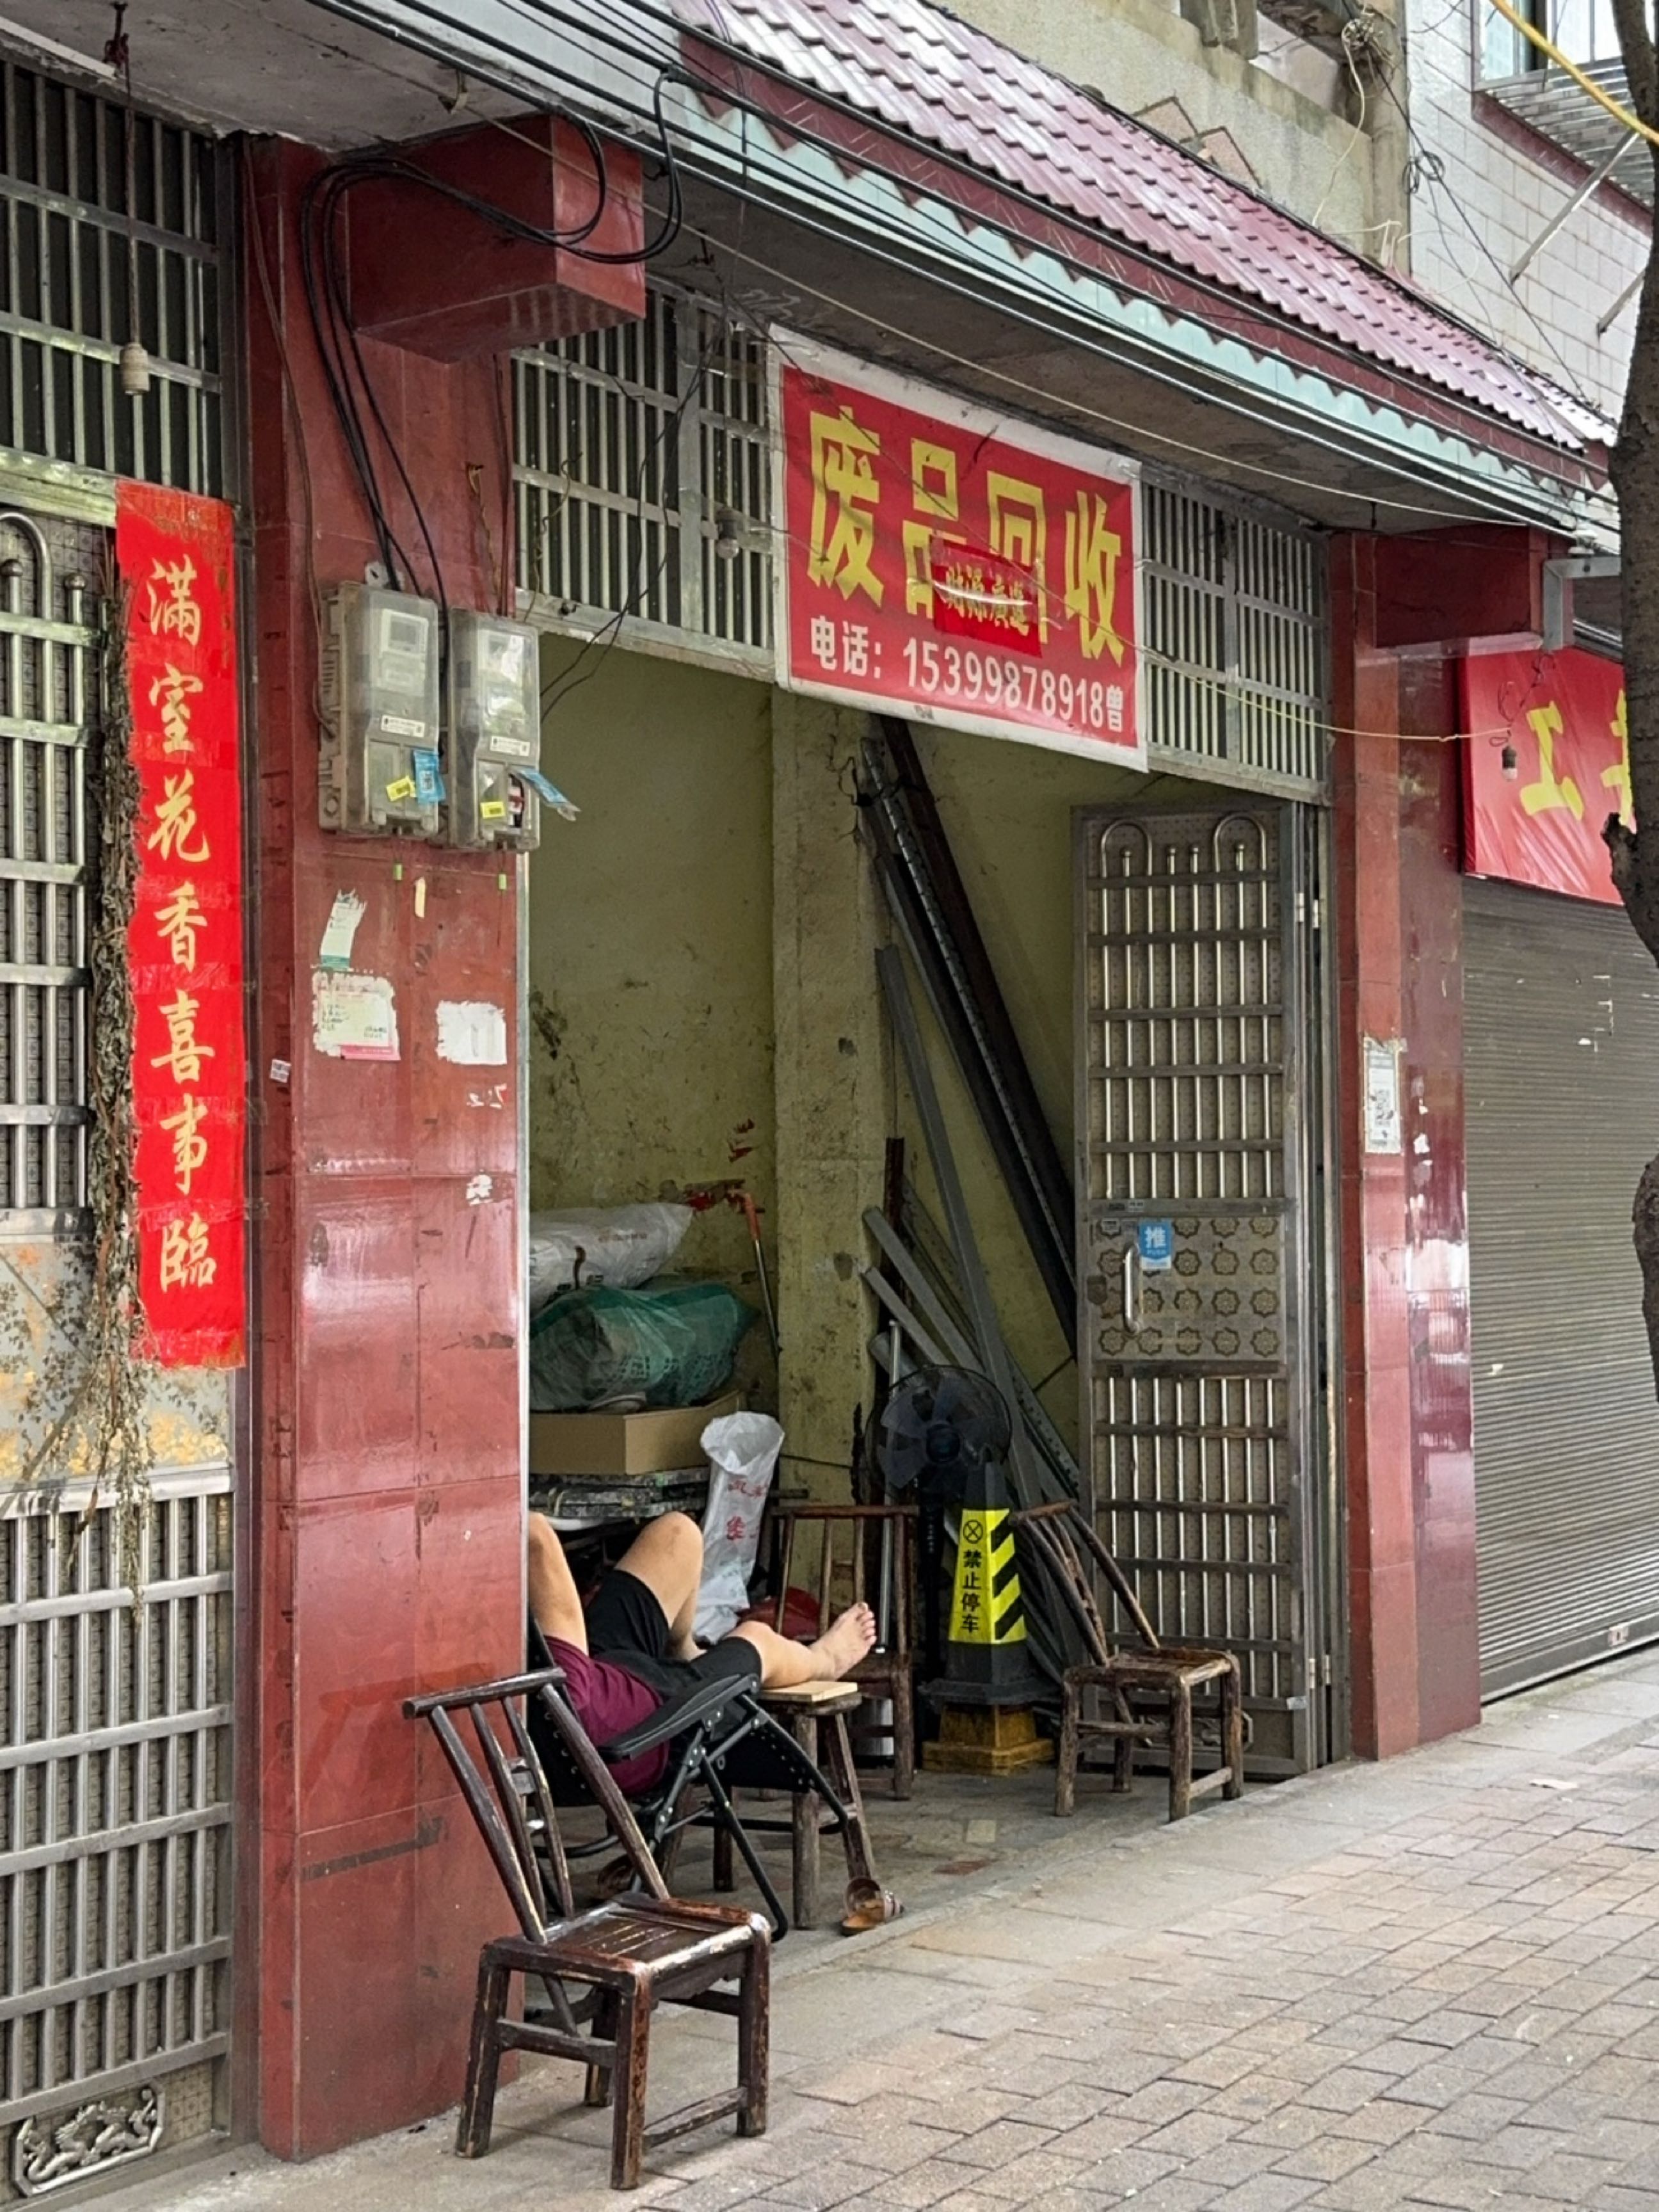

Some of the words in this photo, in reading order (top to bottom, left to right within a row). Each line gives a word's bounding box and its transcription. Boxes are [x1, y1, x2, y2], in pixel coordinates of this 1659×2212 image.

[808, 406, 1123, 667] 废品回收
[1144, 1226, 1167, 1249] 推
[960, 1549, 982, 1633] 禁止停车
